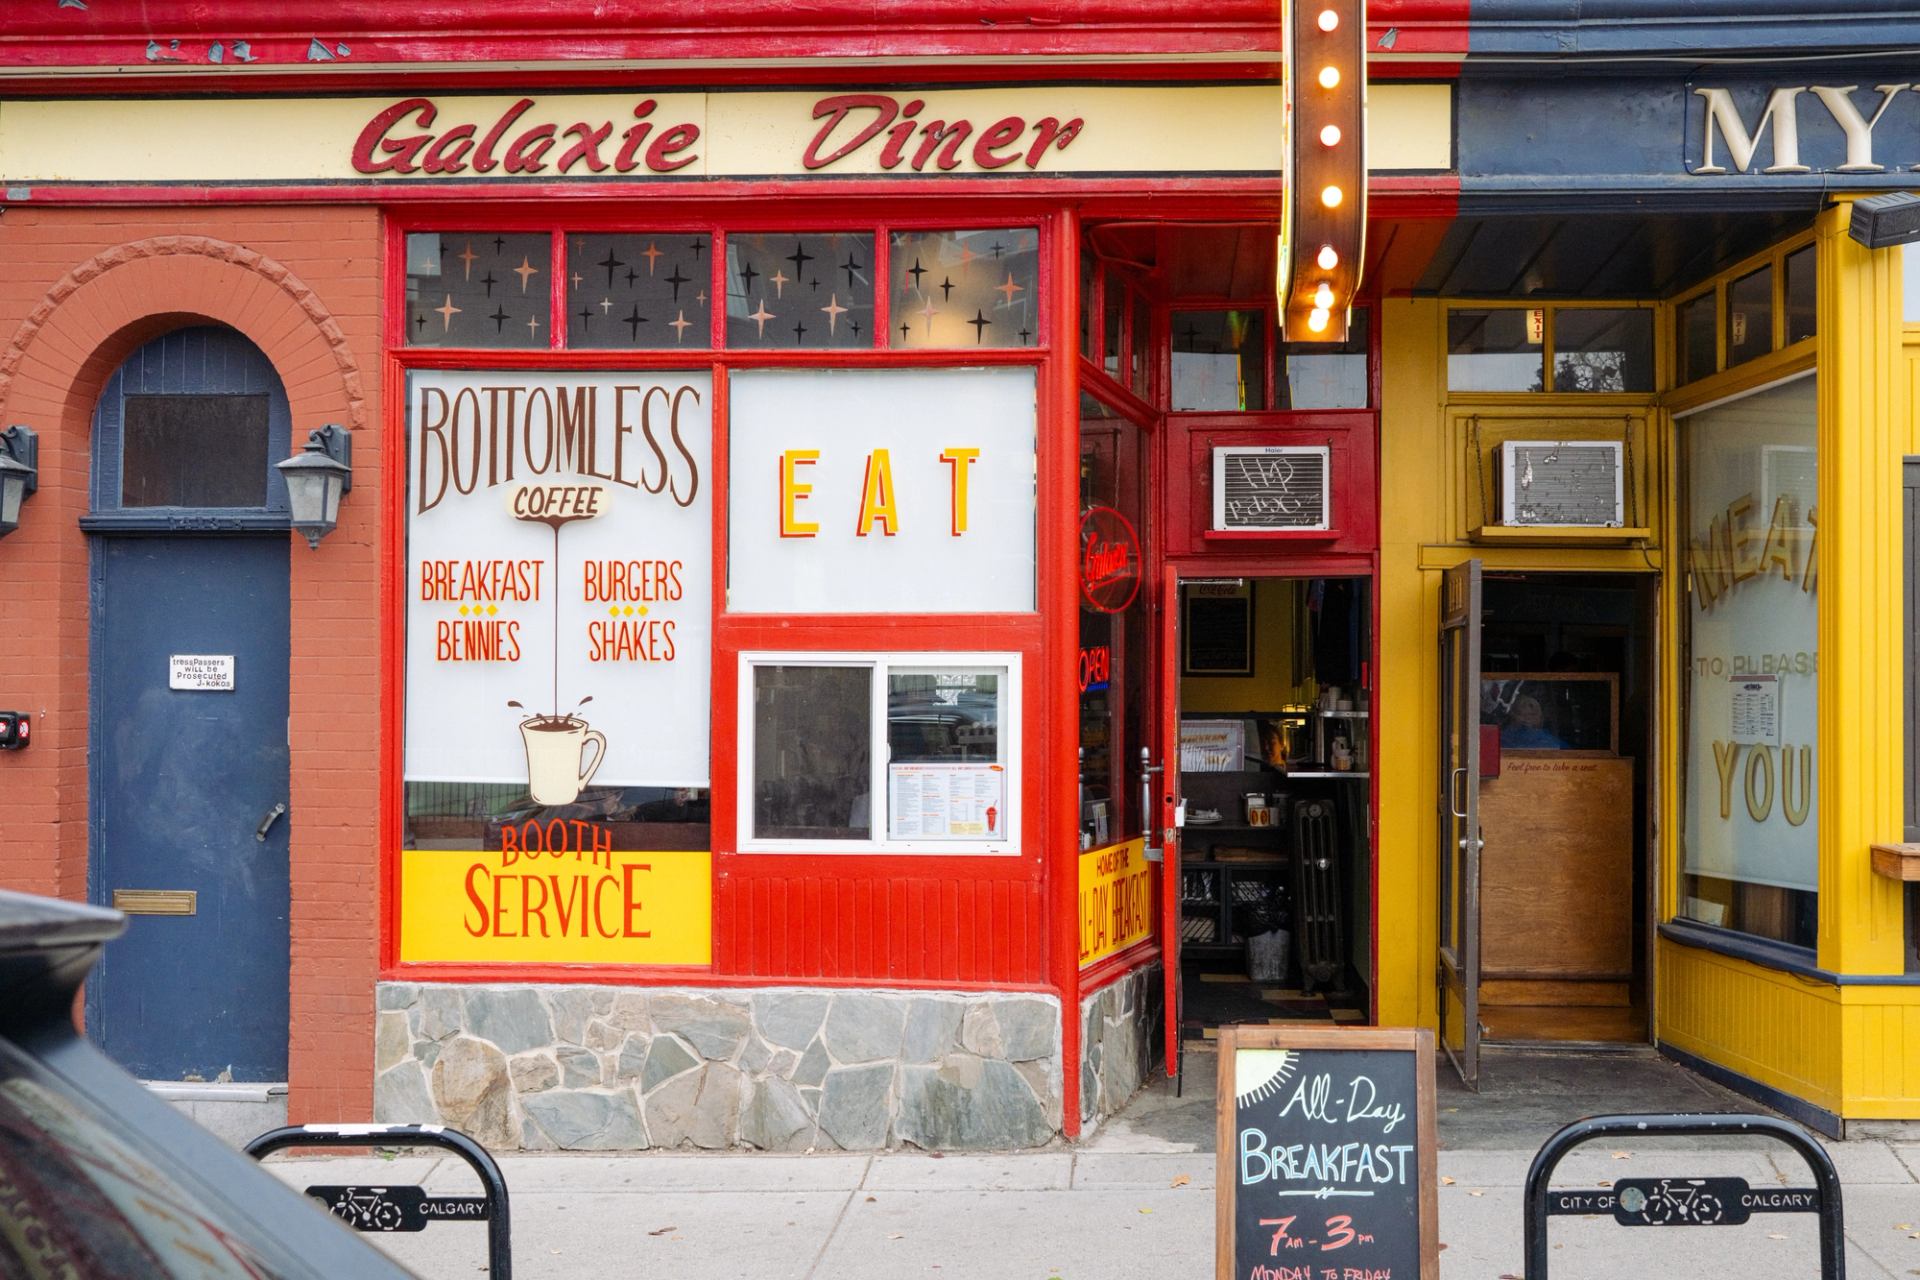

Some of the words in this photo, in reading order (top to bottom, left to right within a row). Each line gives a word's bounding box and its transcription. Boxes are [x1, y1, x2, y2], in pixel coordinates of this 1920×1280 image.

[351, 97, 699, 175] Galaxie
[802, 94, 1085, 171] Diner
[1693, 82, 1920, 174] MY
[1533, 310, 1543, 339] EXIT
[417, 385, 700, 516] BOTTOMLESS
[513, 486, 603, 514] COFFEE
[779, 447, 980, 538] EAT
[421, 560, 545, 602] BREAKFAST
[584, 560, 683, 602] BURGERS
[437, 620, 521, 662] BENNIES
[588, 620, 676, 662] SHAKES
[1079, 646, 1110, 693] OPEN
[1696, 657, 1724, 676] TO
[1712, 740, 1812, 827] YOU
[501, 817, 612, 871] BOOTH
[464, 862, 652, 939] SERVICE
[1080, 883, 1108, 959] LL-DAY
[1279, 1073, 1406, 1133] All-Day
[1240, 1127, 1414, 1185] BREAKFAST
[419, 1202, 485, 1215] CALGARY
[1560, 1196, 1592, 1209] CITY
[1597, 1196, 1616, 1209] OF
[1741, 1194, 1813, 1207] CALGARY
[1250, 1264, 1311, 1280] MONDAY
[1343, 1268, 1391, 1280] FRIDAY
